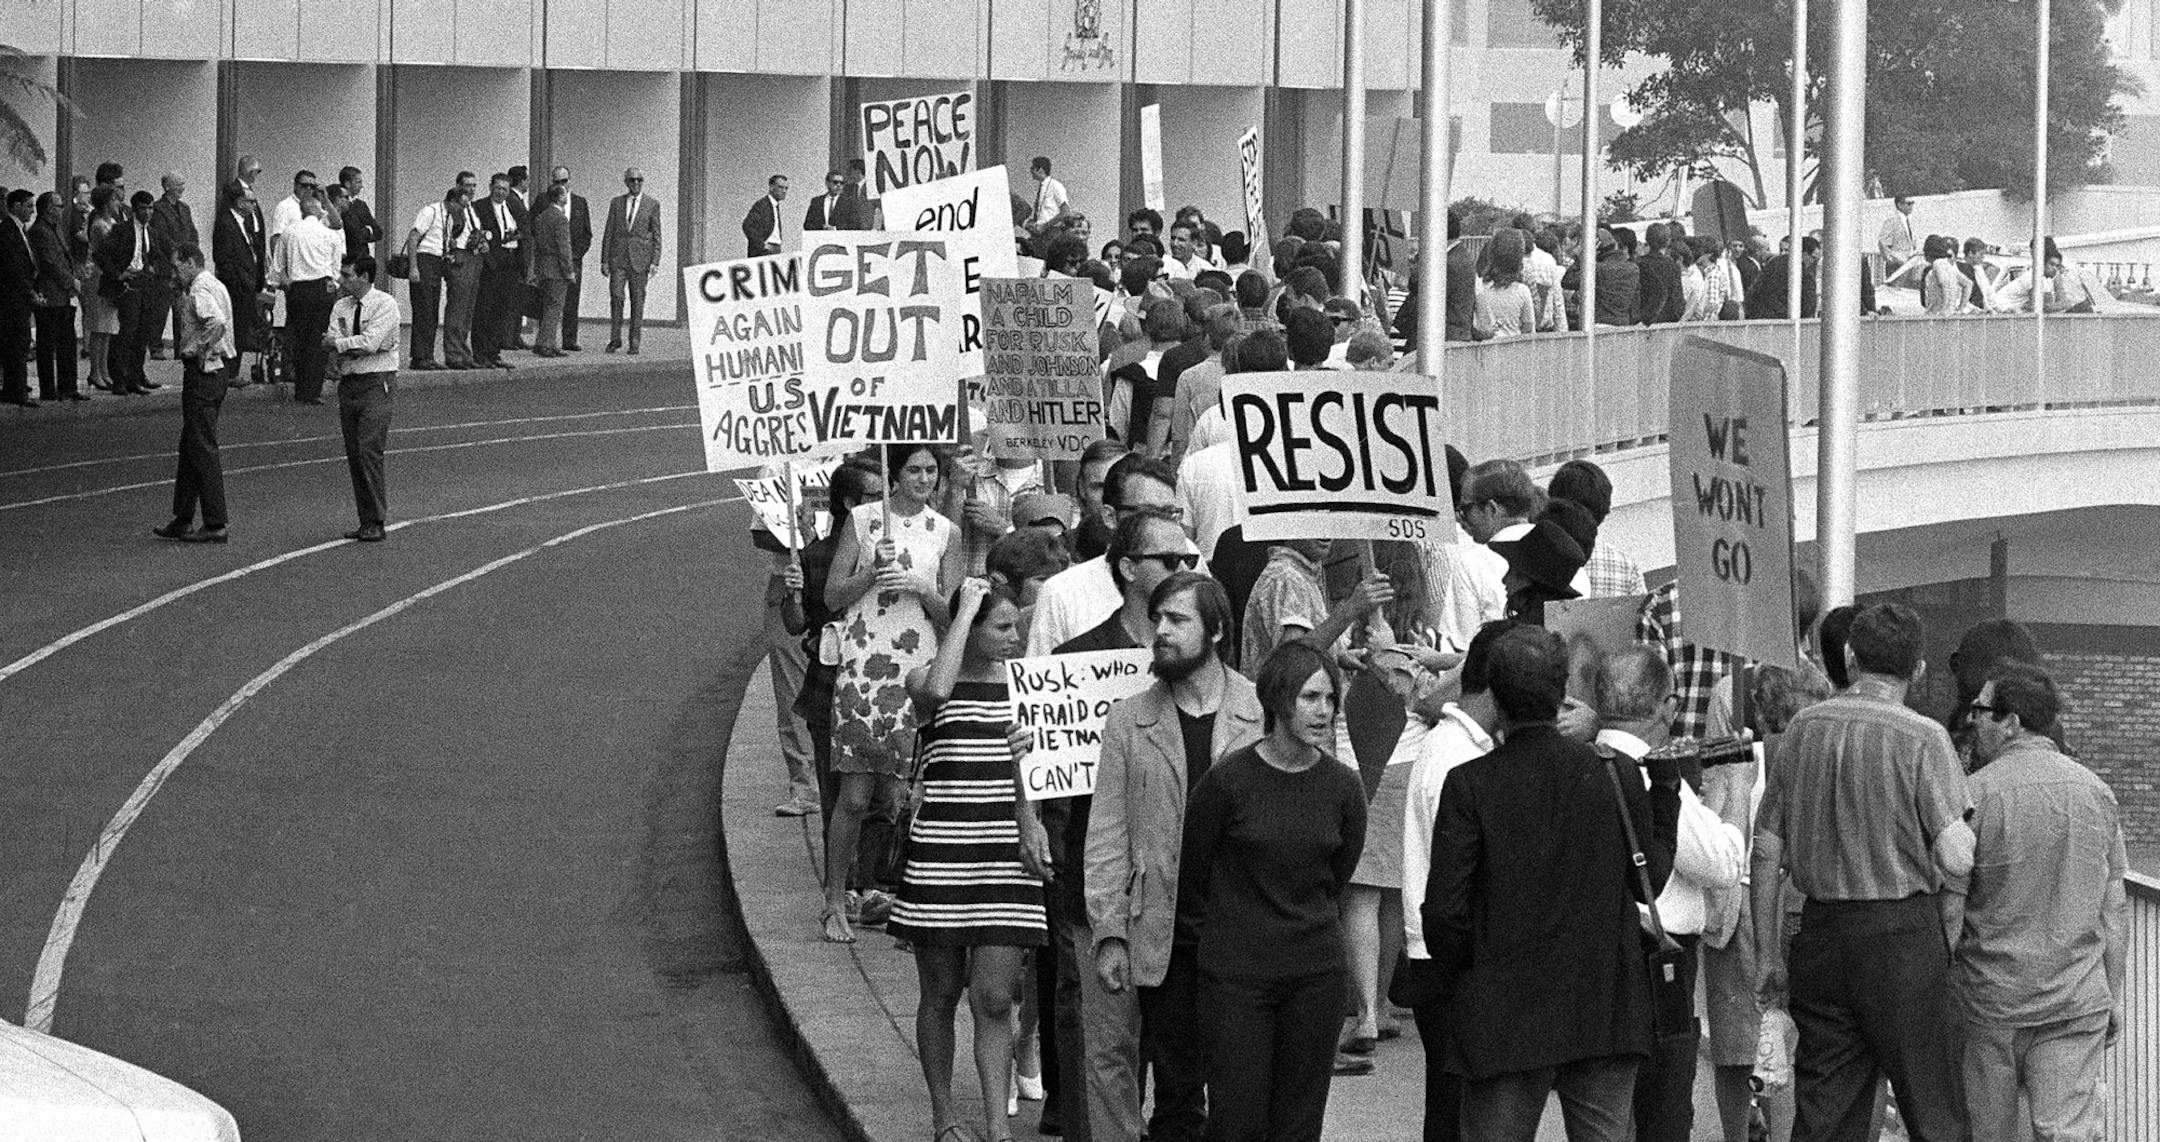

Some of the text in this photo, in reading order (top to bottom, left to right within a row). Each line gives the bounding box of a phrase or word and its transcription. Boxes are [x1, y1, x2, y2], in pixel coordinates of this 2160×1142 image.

[863, 93, 971, 152] PEACE
[875, 141, 969, 195] NOW
[915, 186, 978, 231] end
[700, 257, 801, 303] CRIM
[807, 240, 947, 297] GET
[986, 283, 1073, 305] NAPALM
[710, 304, 802, 345] AGAIN
[825, 305, 940, 364] OUT
[992, 307, 1005, 327] A
[1013, 306, 1073, 327] CHILD
[985, 329, 1023, 351] FOR
[705, 342, 804, 383] HUMANI
[985, 354, 1100, 377] AND JOHNSON
[850, 377, 885, 398] OF
[986, 377, 1024, 397] AND
[807, 387, 957, 443] VIETNAM
[986, 399, 1101, 425] AND HITLER
[1005, 434, 1091, 452] BERKELEY VDC
[1232, 391, 1439, 497] RESIST
[1703, 412, 1750, 466] WE
[1693, 472, 1767, 529] WONT
[1388, 518, 1426, 539] SDS
[1712, 538, 1751, 586] GO
[1091, 660, 1138, 680] WHO
[1029, 761, 1095, 792] CAN'T
